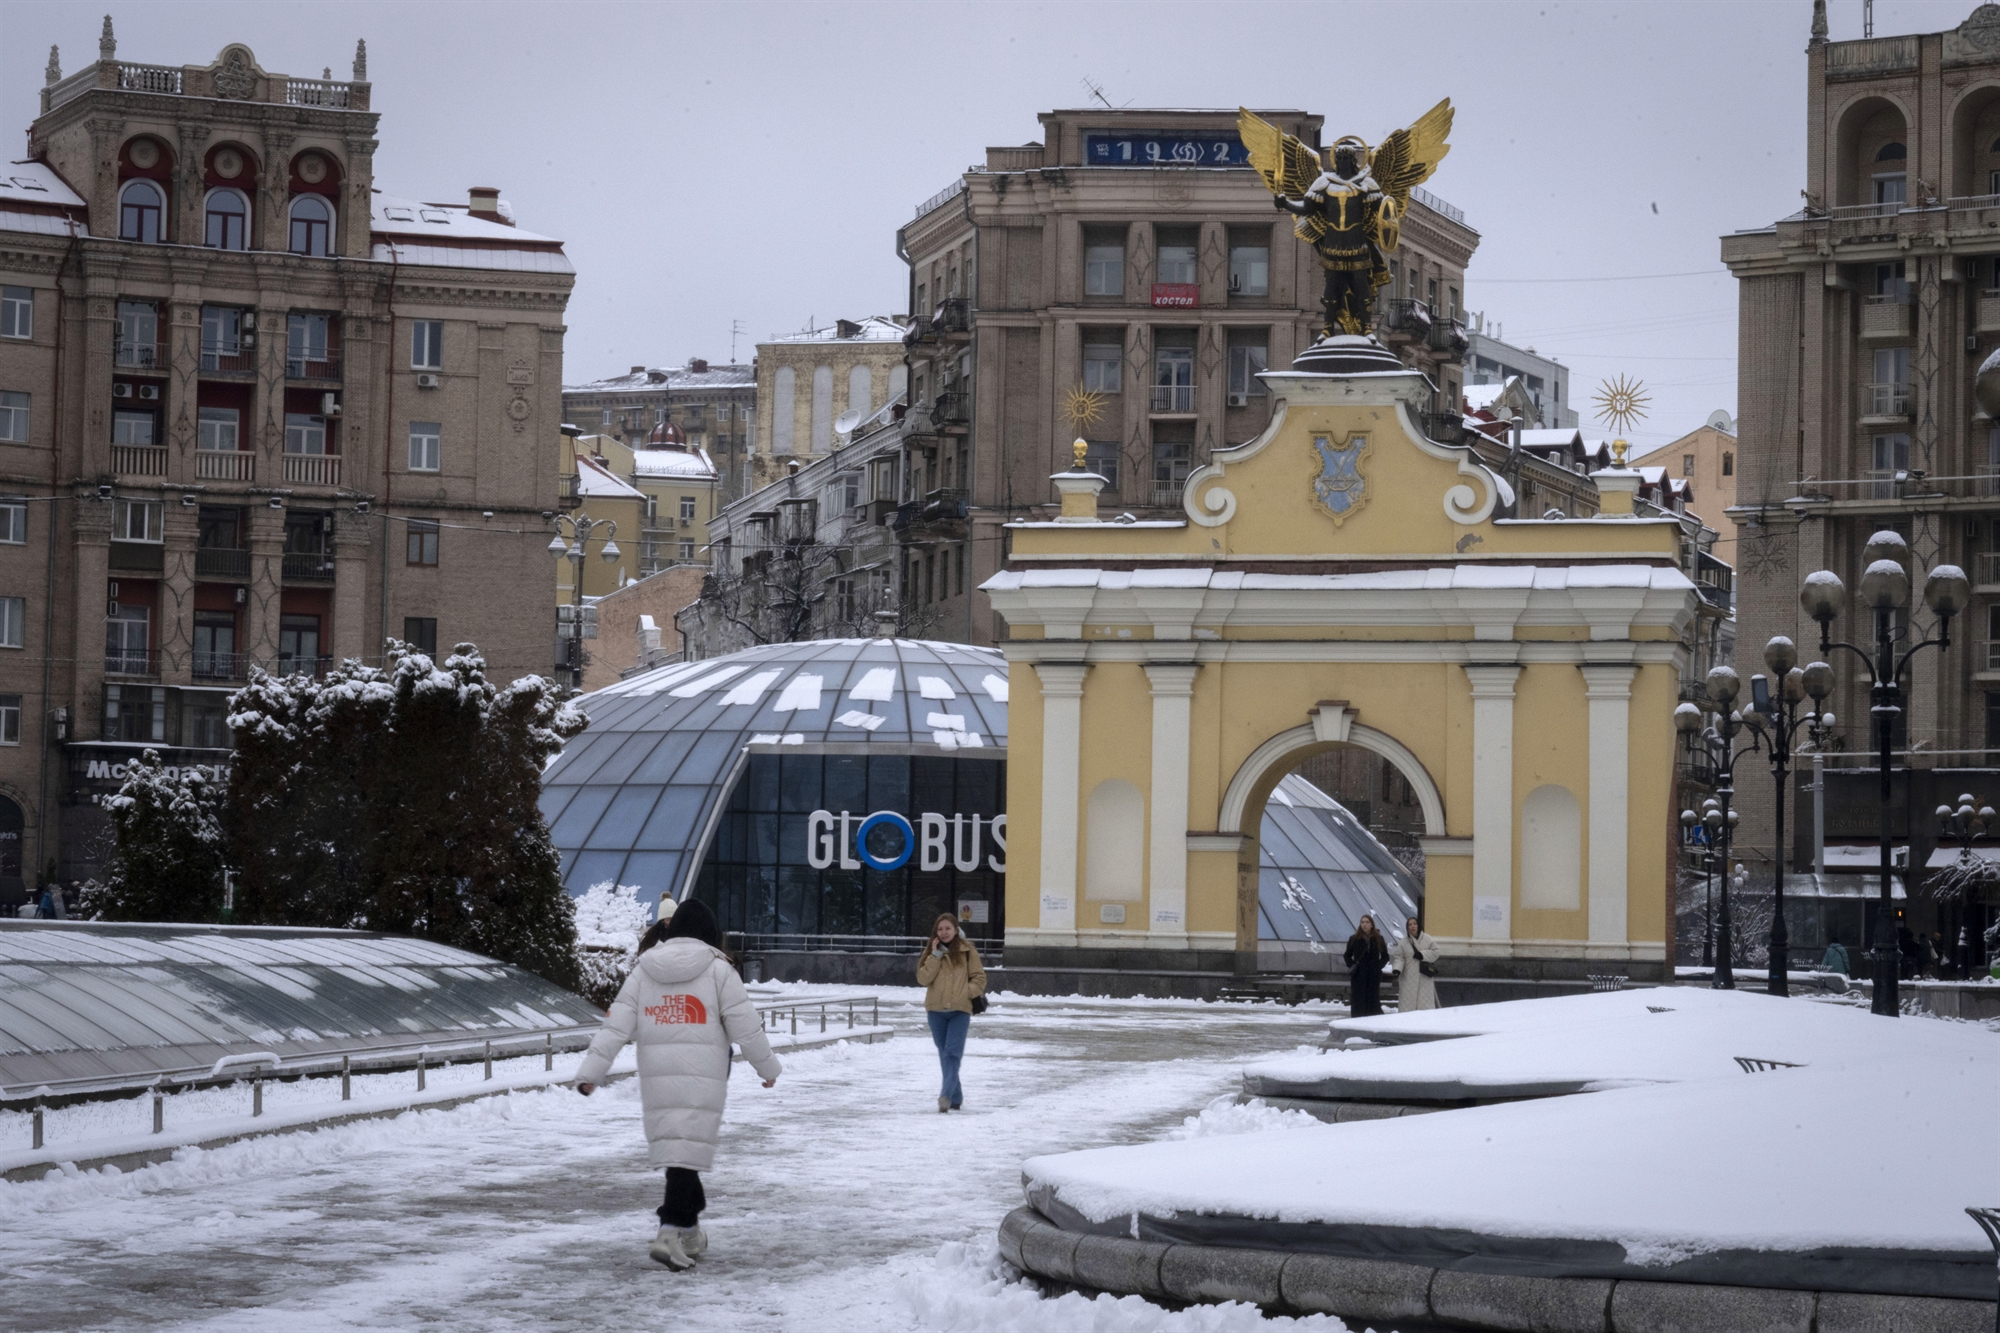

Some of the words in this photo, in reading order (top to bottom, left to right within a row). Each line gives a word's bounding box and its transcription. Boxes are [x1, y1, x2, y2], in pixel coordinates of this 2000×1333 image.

[808, 810, 1006, 873] GLOBUS
[662, 994, 685, 1005] THE
[644, 1005, 685, 1016] NORTH
[655, 1014, 685, 1025] FACE
